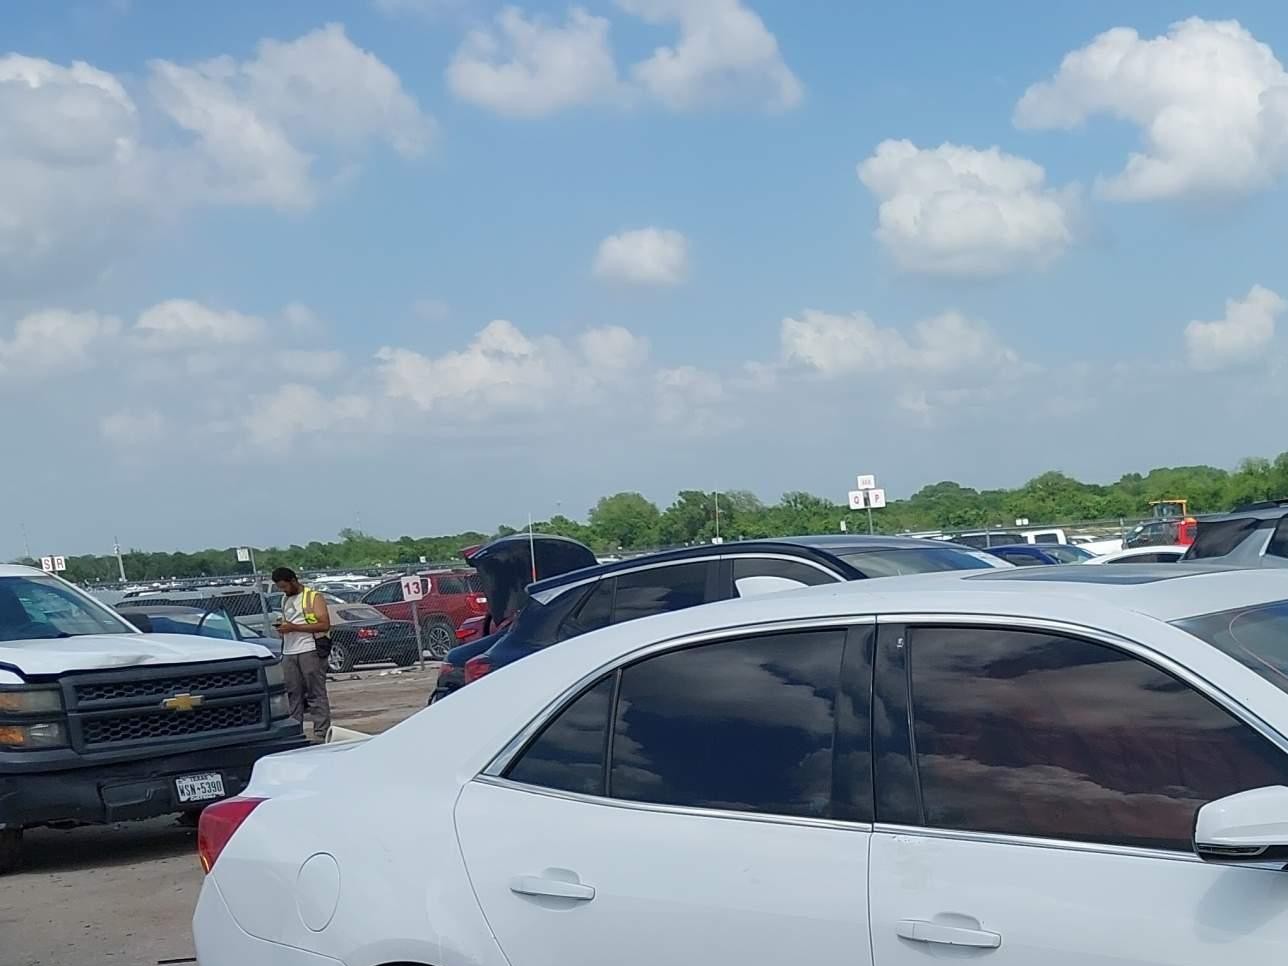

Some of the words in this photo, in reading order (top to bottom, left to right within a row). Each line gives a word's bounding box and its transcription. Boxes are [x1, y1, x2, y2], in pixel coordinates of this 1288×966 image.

[43, 559, 51, 570] S
[56, 558, 64, 569] R
[404, 581, 421, 595] 13
